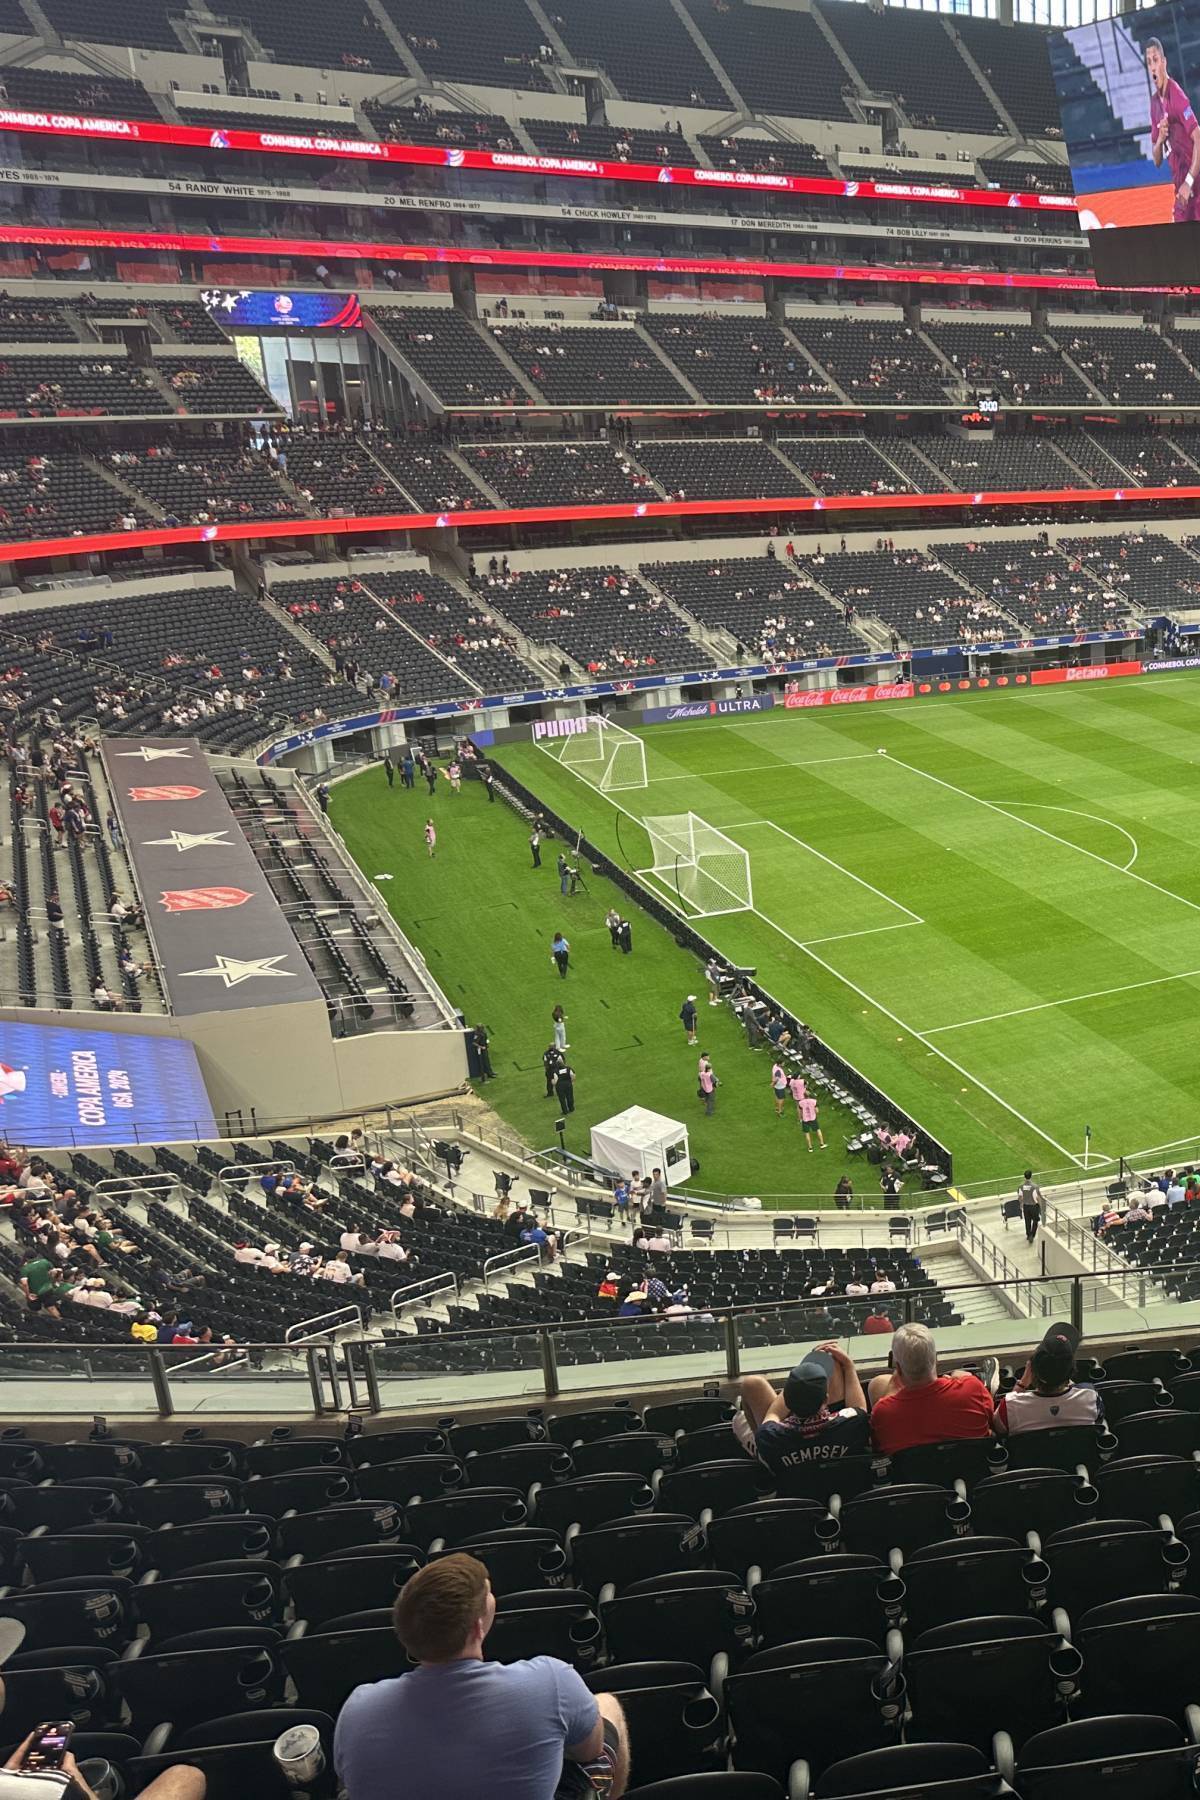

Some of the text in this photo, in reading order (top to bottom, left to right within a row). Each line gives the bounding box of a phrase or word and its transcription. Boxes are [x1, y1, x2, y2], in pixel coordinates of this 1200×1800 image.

[51, 117, 81, 129] COPA
[82, 120, 130, 134] AMERICA
[260, 134, 314, 149] CONMEBOL
[315, 141, 340, 151] COPA
[340, 142, 382, 155] AMERICA
[492, 154, 597, 172] CONMEBOL COPA AMERICA
[694, 171, 735, 183] CONMEBOL
[168, 182, 181, 191] 54
[186, 183, 220, 193] RANDY
[224, 185, 255, 195] WHITE
[384, 197, 395, 205] 20
[400, 198, 416, 207] MEL
[419, 199, 450, 208] RENFRO
[561, 208, 571, 216] 54
[575, 210, 598, 218] CHUCK
[601, 211, 631, 220] HOWLEY
[741, 220, 756, 228] DON
[758, 221, 791, 229] MEREDITH
[1149, 661, 1184, 671] CONMEBOL
[1066, 667, 1108, 681] Betano
[718, 700, 760, 713] ULTRA
[534, 716, 587, 739] PUMA
[71, 1051, 106, 1126] COPA AMERICA
[107, 1070, 134, 1108] USA 2024
[781, 1445, 848, 1467] DEMPSEY
